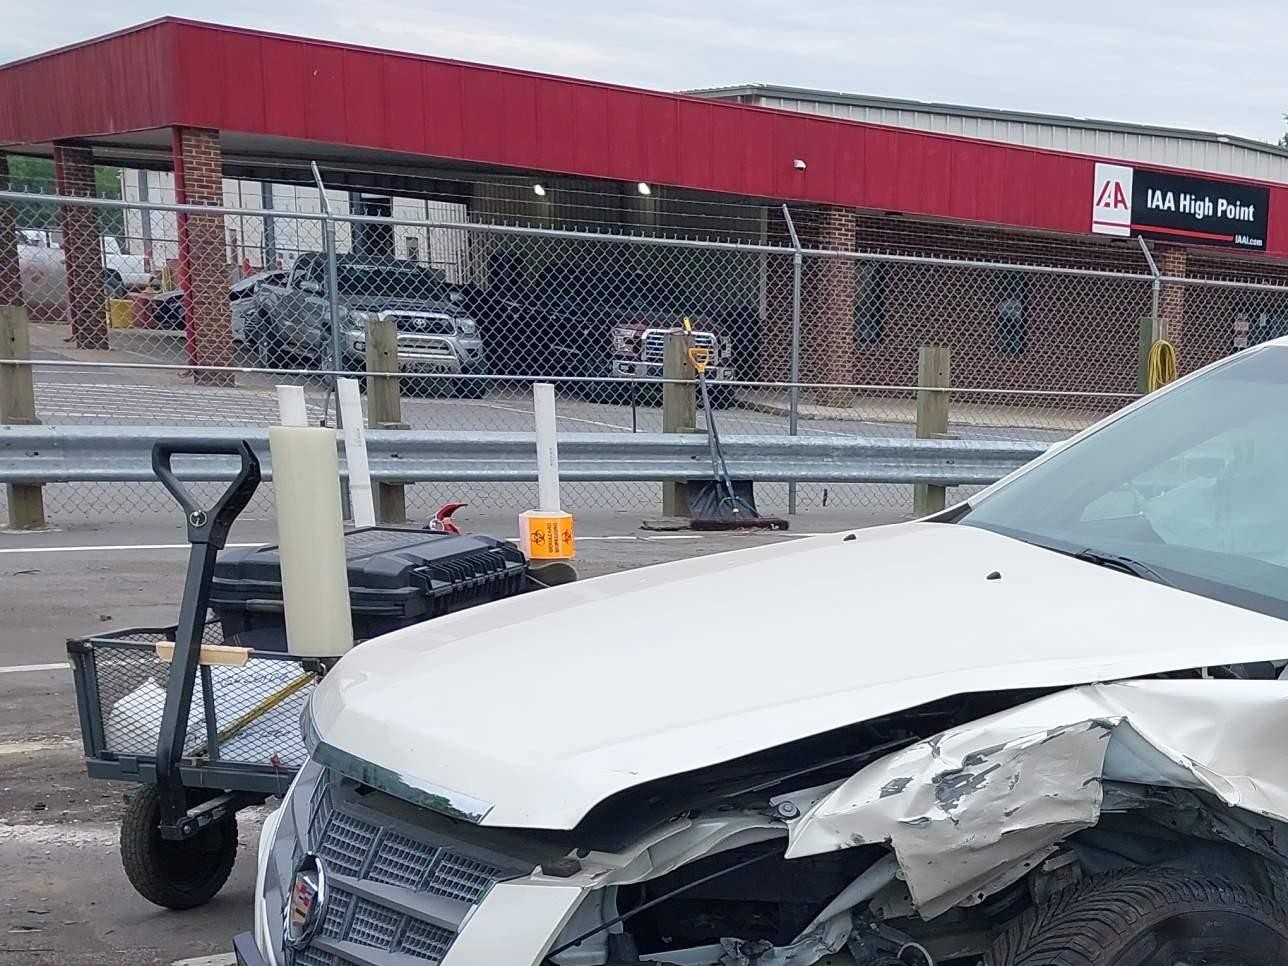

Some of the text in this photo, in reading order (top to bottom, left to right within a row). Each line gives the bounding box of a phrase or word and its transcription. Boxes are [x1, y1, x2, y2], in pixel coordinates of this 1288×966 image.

[1147, 189, 1255, 221] IAA High Point
